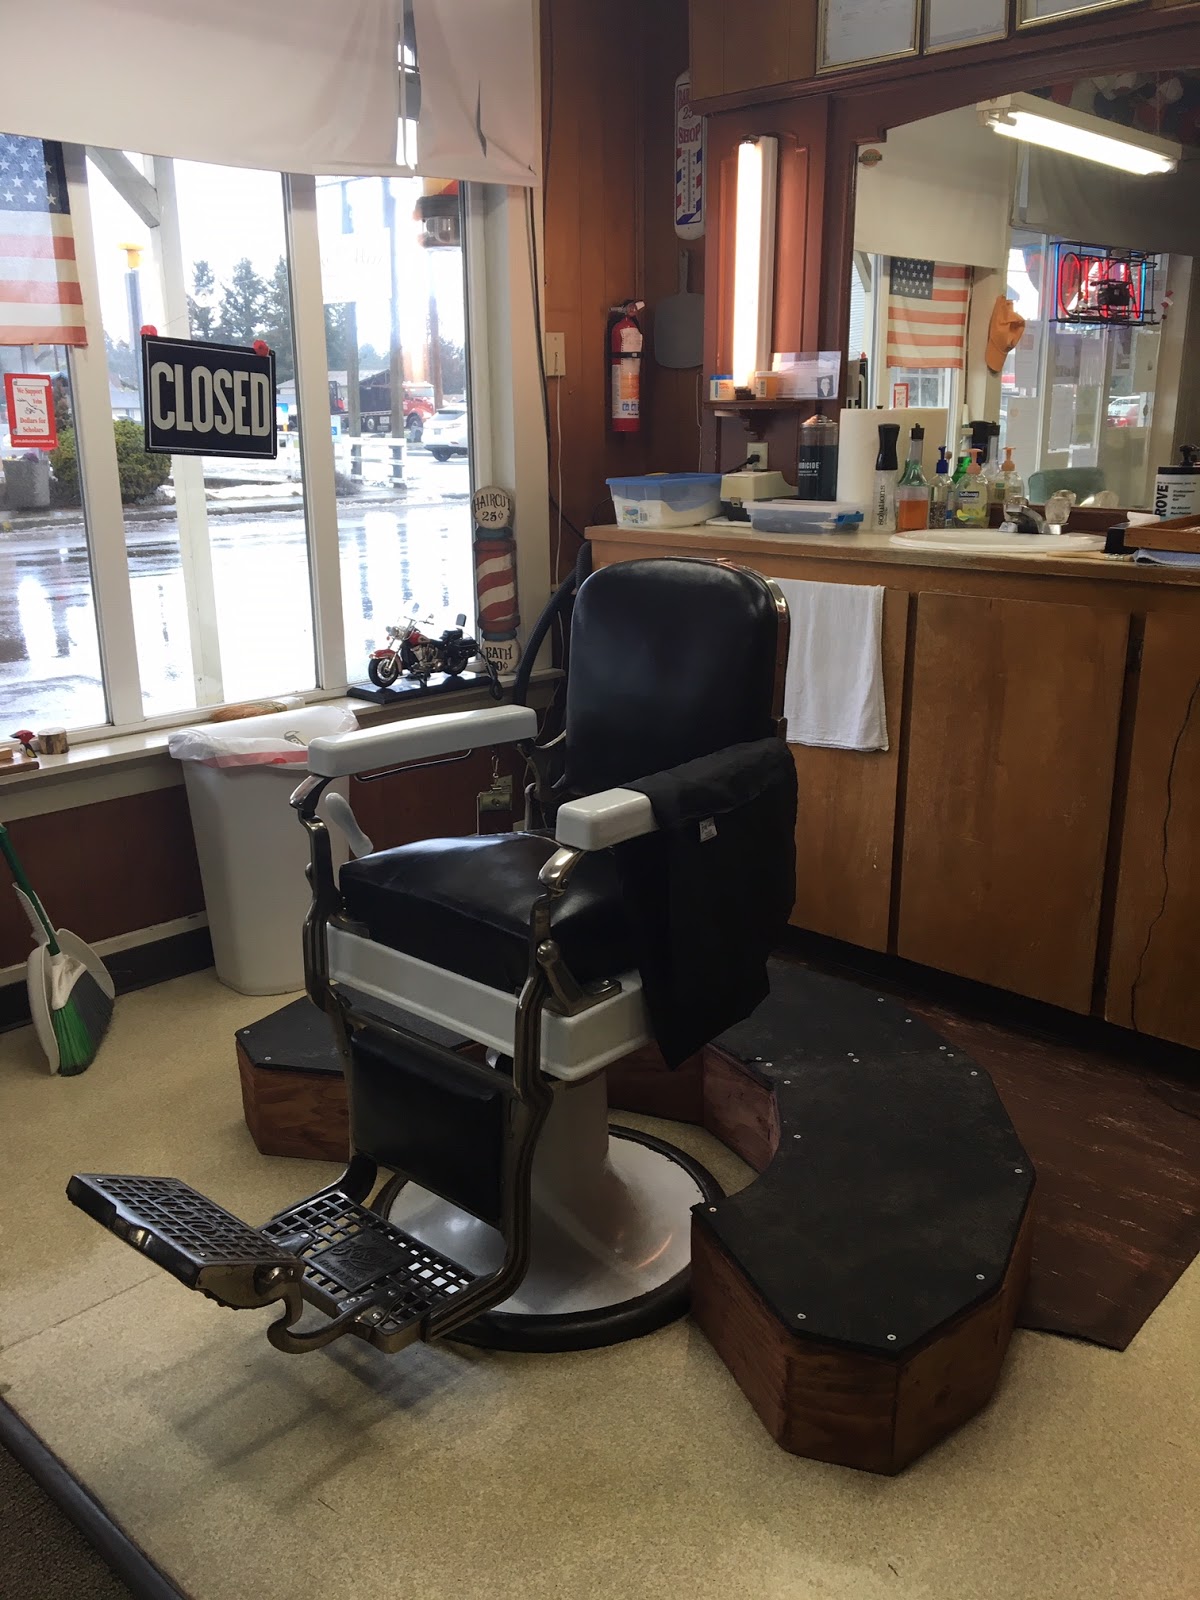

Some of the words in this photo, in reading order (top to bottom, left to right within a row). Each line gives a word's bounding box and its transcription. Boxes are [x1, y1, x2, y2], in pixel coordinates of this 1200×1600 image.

[678, 123, 701, 144] SHOP
[25, 388, 42, 396] Support
[150, 361, 270, 437] CLOSED
[473, 493, 511, 514] HAIRCUT
[877, 484, 886, 526] solutions
[482, 510, 504, 522] 25¢
[485, 644, 514, 660] BATH
